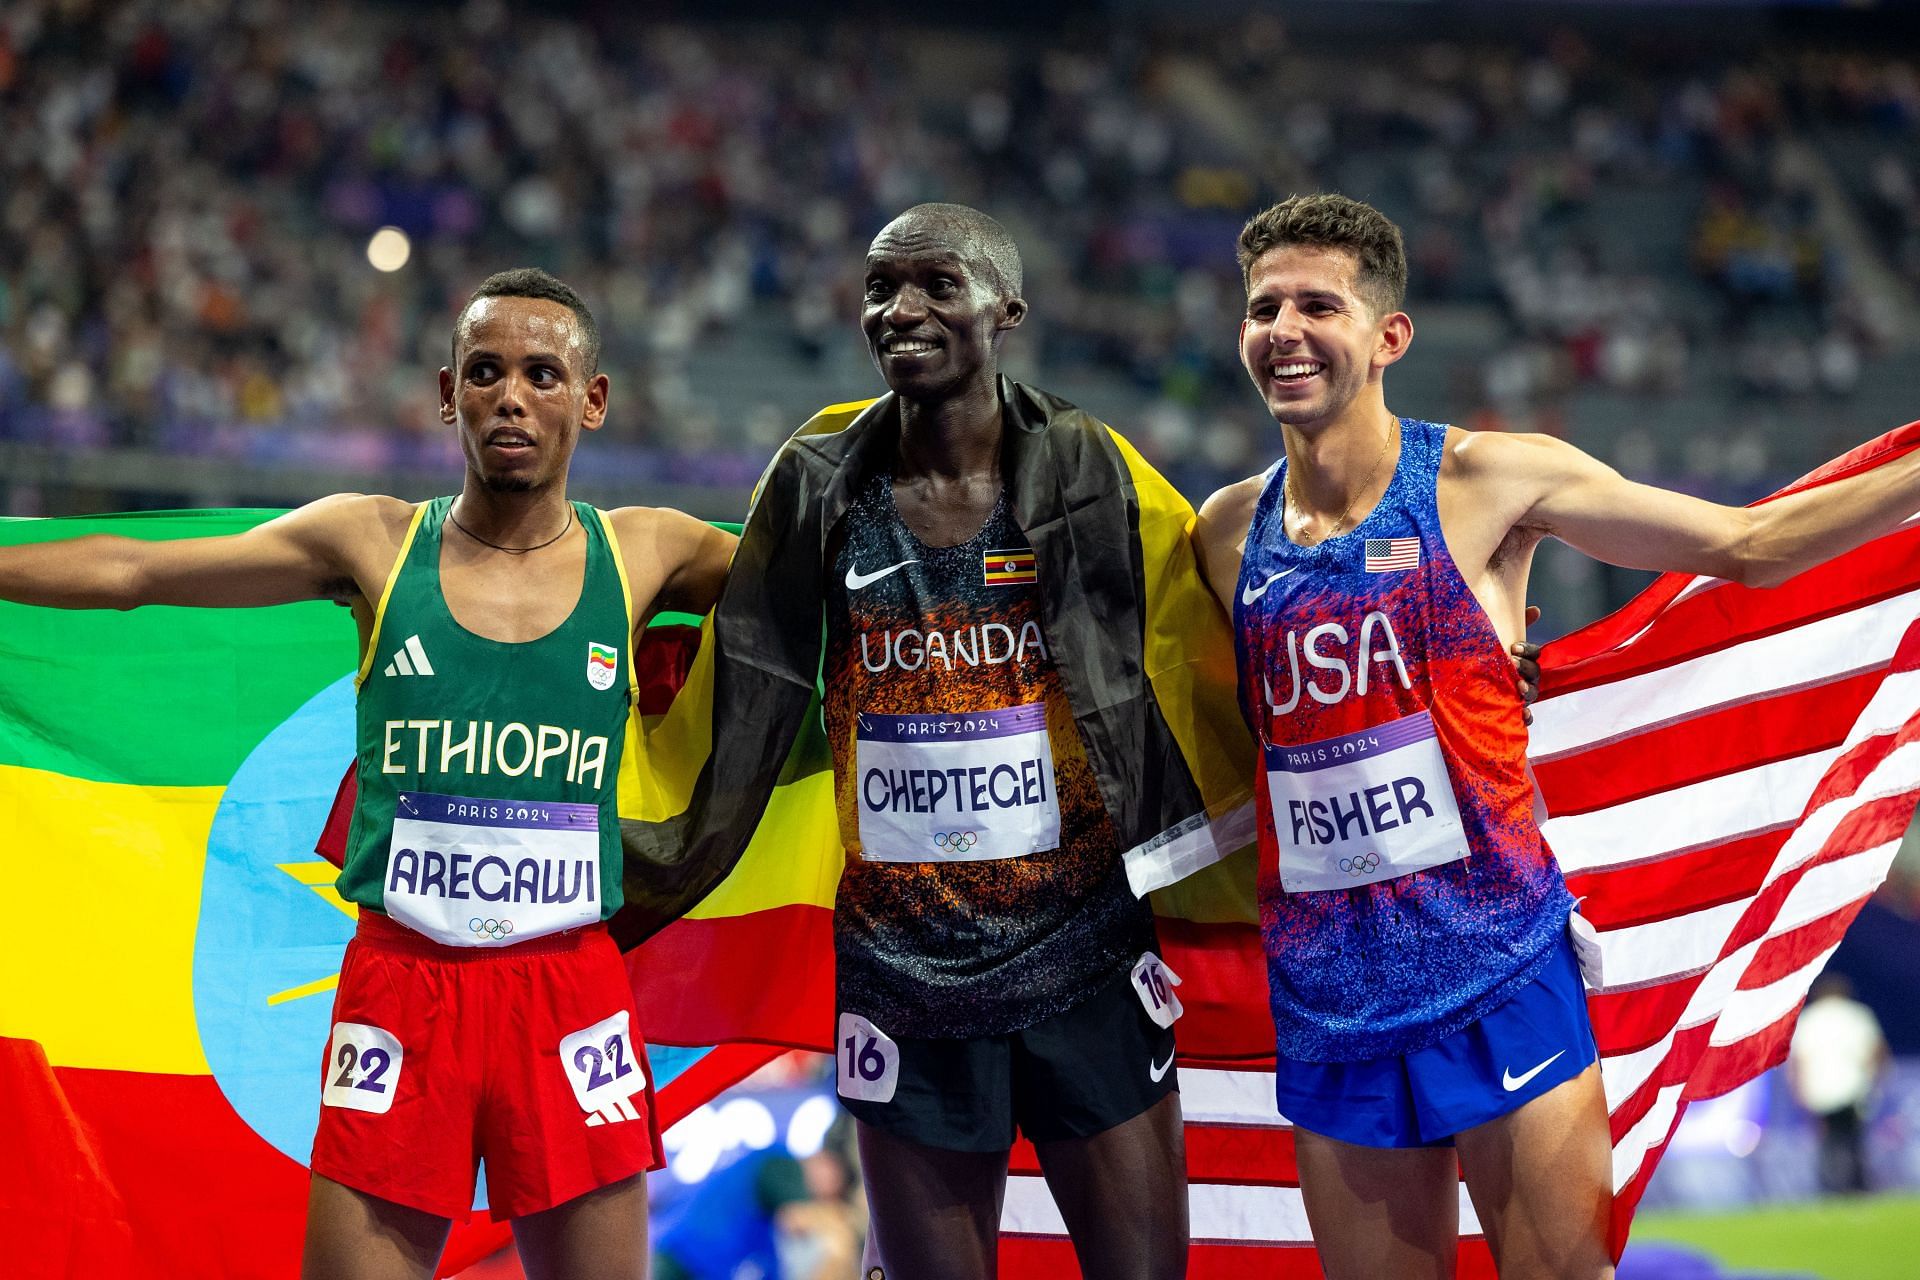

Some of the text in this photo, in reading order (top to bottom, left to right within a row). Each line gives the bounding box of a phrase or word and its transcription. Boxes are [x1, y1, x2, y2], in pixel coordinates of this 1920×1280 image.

[861, 621, 1048, 672] UGANDA
[1264, 611, 1412, 715] USA
[954, 718, 999, 734] 2024
[1332, 736, 1379, 758] 2024
[383, 720, 608, 789] ETHIOPIA
[863, 758, 1047, 813] CHEPTEGEI
[1289, 776, 1434, 846] FISHER
[505, 807, 549, 821] 2024
[390, 848, 596, 904] AREGAWI
[1139, 964, 1167, 1010] 16
[334, 1043, 391, 1094] 22
[574, 1034, 632, 1092] 22
[845, 1036, 886, 1081] 16
